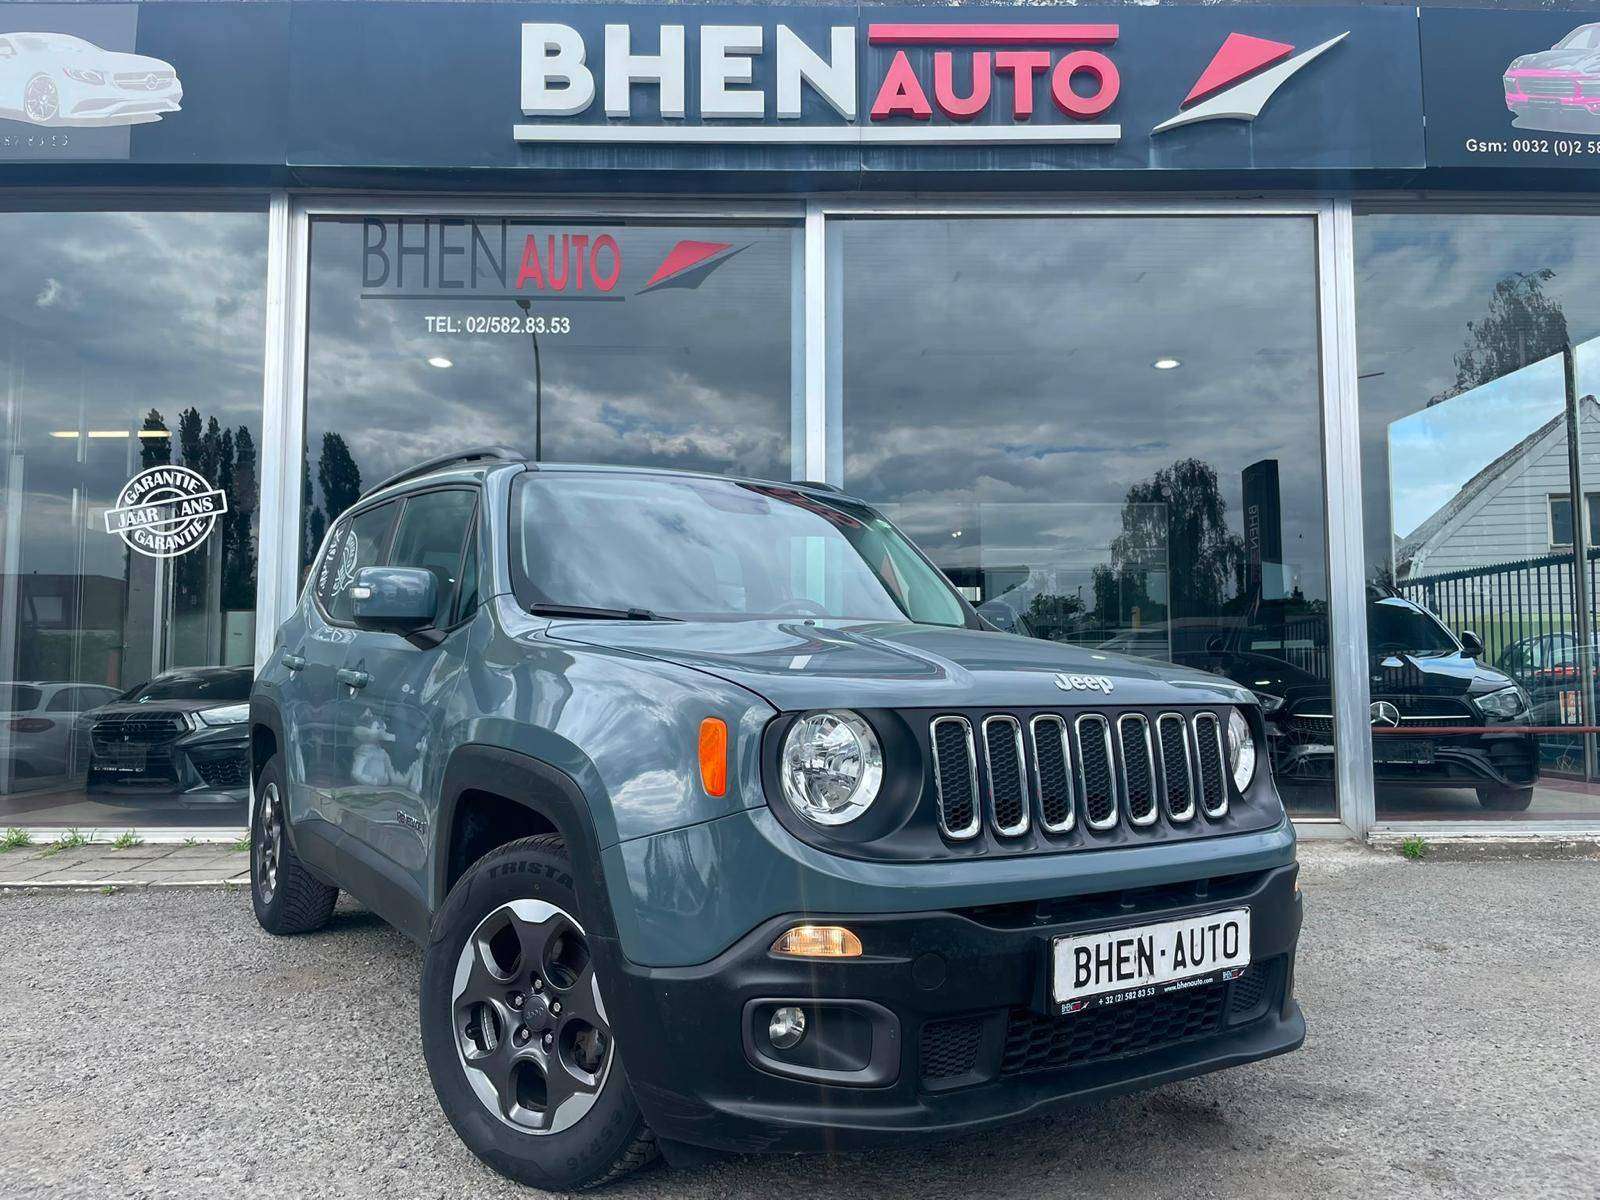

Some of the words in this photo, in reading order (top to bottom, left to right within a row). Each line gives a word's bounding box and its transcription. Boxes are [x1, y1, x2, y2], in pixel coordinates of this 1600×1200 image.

[520, 23, 857, 121] BHEN
[869, 50, 1120, 121] AUTO
[1466, 139, 1507, 153] Gsm:
[1513, 140, 1548, 153] 0032
[1554, 140, 1582, 156] (0)2
[362, 217, 507, 289] BHEN
[516, 234, 621, 292] AUTO
[424, 316, 461, 333] TEL:
[466, 317, 571, 334] 02/582.83.53
[124, 471, 201, 505] GARANTIE
[118, 507, 160, 528] JAAR
[181, 497, 214, 517] ANS
[134, 516, 207, 550] GARANTIE
[1054, 673, 1114, 695] Jeep
[1105, 995, 1114, 1005] 32
[1124, 991, 1137, 1001] 582
[1137, 989, 1147, 998] 83
[1146, 987, 1155, 997] 53
